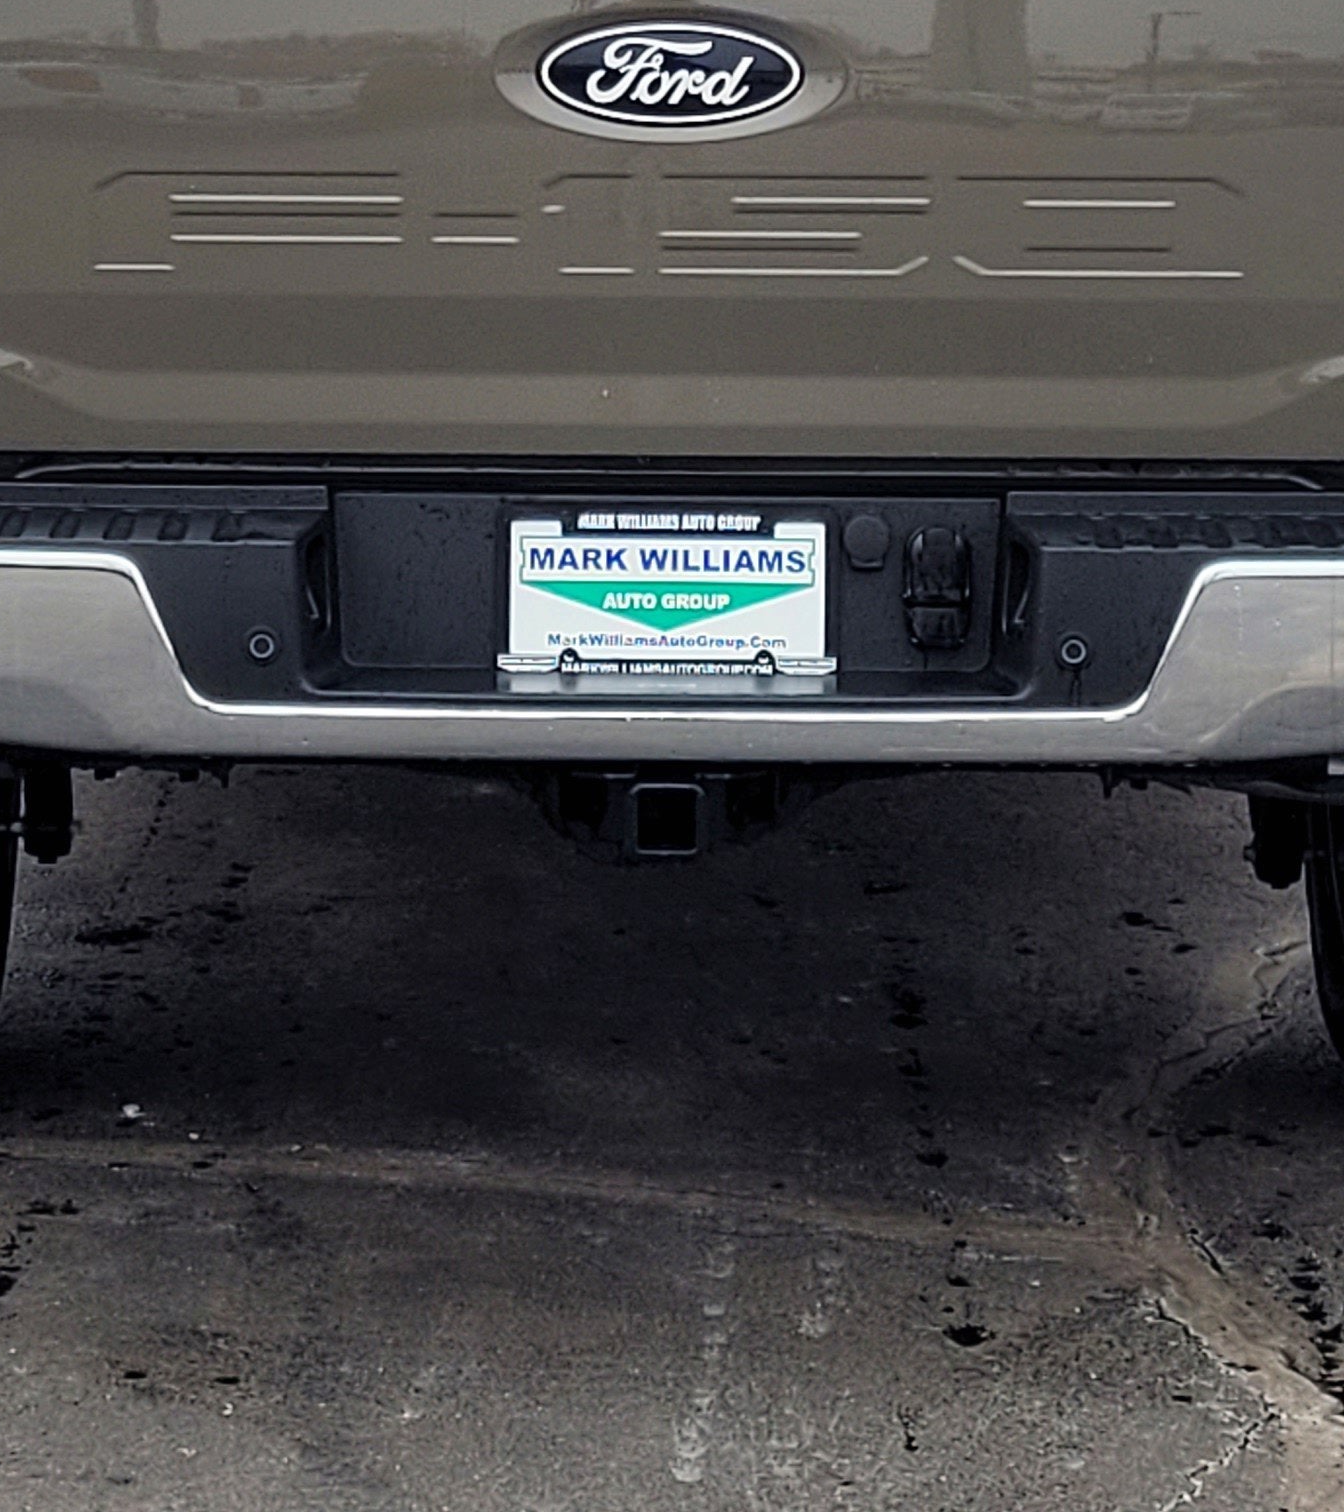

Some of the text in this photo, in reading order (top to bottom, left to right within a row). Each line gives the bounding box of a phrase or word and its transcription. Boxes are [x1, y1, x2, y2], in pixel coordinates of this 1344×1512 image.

[586, 37, 755, 106] Ford
[577, 514, 761, 531] MARK WILLIAMS AUTO GROUP
[529, 548, 807, 573] MARK WILLIAMS
[603, 592, 731, 610] AUTO GROUP
